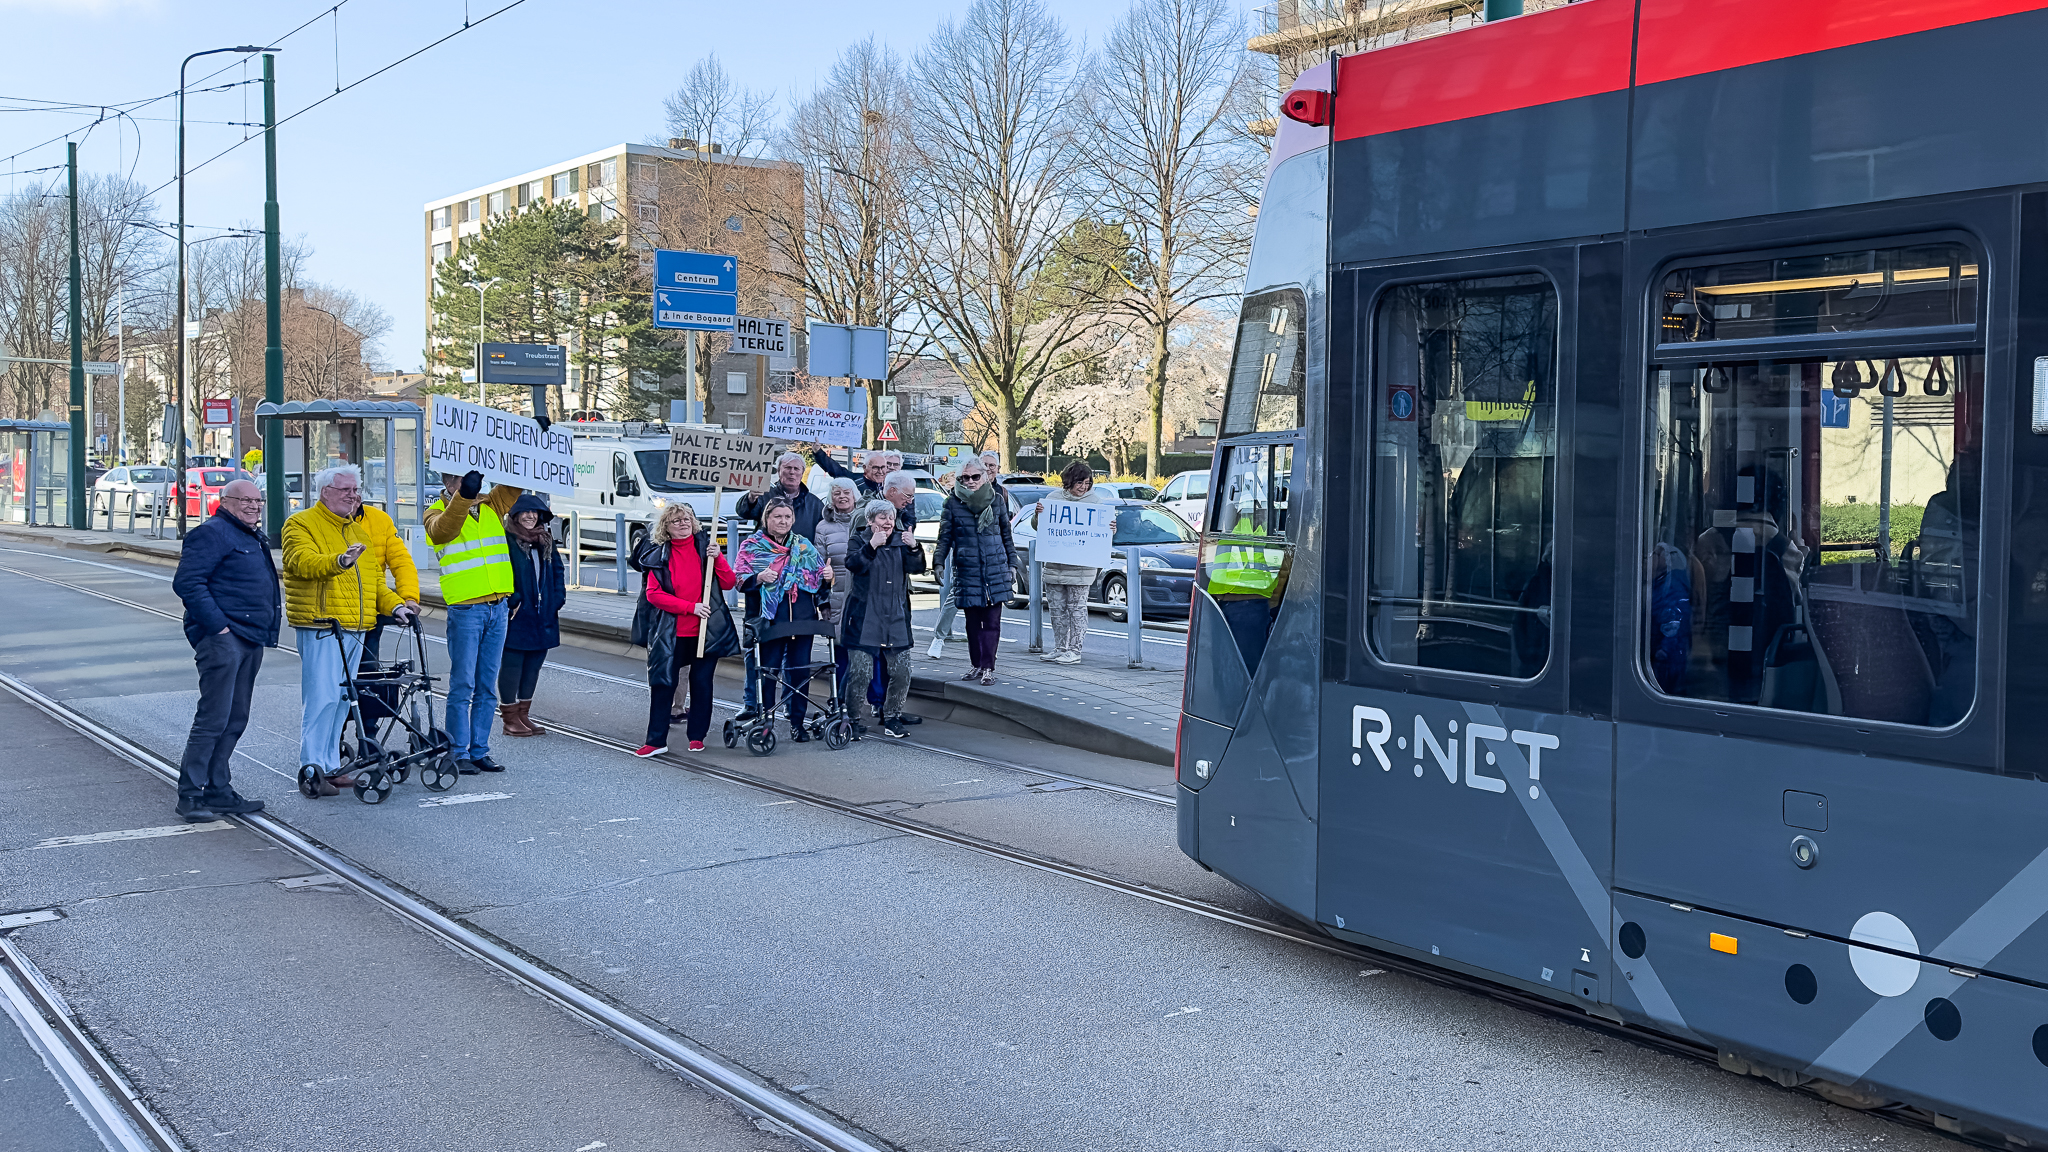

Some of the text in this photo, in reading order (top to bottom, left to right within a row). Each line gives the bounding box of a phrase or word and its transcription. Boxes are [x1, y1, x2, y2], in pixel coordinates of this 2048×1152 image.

[677, 274, 716, 284] Centrum
[672, 312, 731, 323] In de Bogaard
[738, 319, 785, 337] HALTE
[738, 336, 784, 352] TERUG
[524, 352, 560, 360] Treubstraat
[770, 403, 777, 413] 5
[768, 414, 792, 424] MAAR
[795, 417, 815, 425] ONZE
[818, 419, 846, 428] HALTE
[486, 415, 539, 448] DEUREN
[540, 430, 573, 456] OPEN
[795, 427, 827, 437] DICHT!
[674, 432, 721, 450] HALTE
[758, 442, 774, 456] 17
[431, 436, 575, 487] LAAT ONS NIET LOPEN
[672, 450, 772, 473] TREUBSTRAAT
[670, 467, 720, 482] TERUG
[1049, 504, 1107, 527] HALTE
[1047, 527, 1089, 537] TREUBSTRAAT
